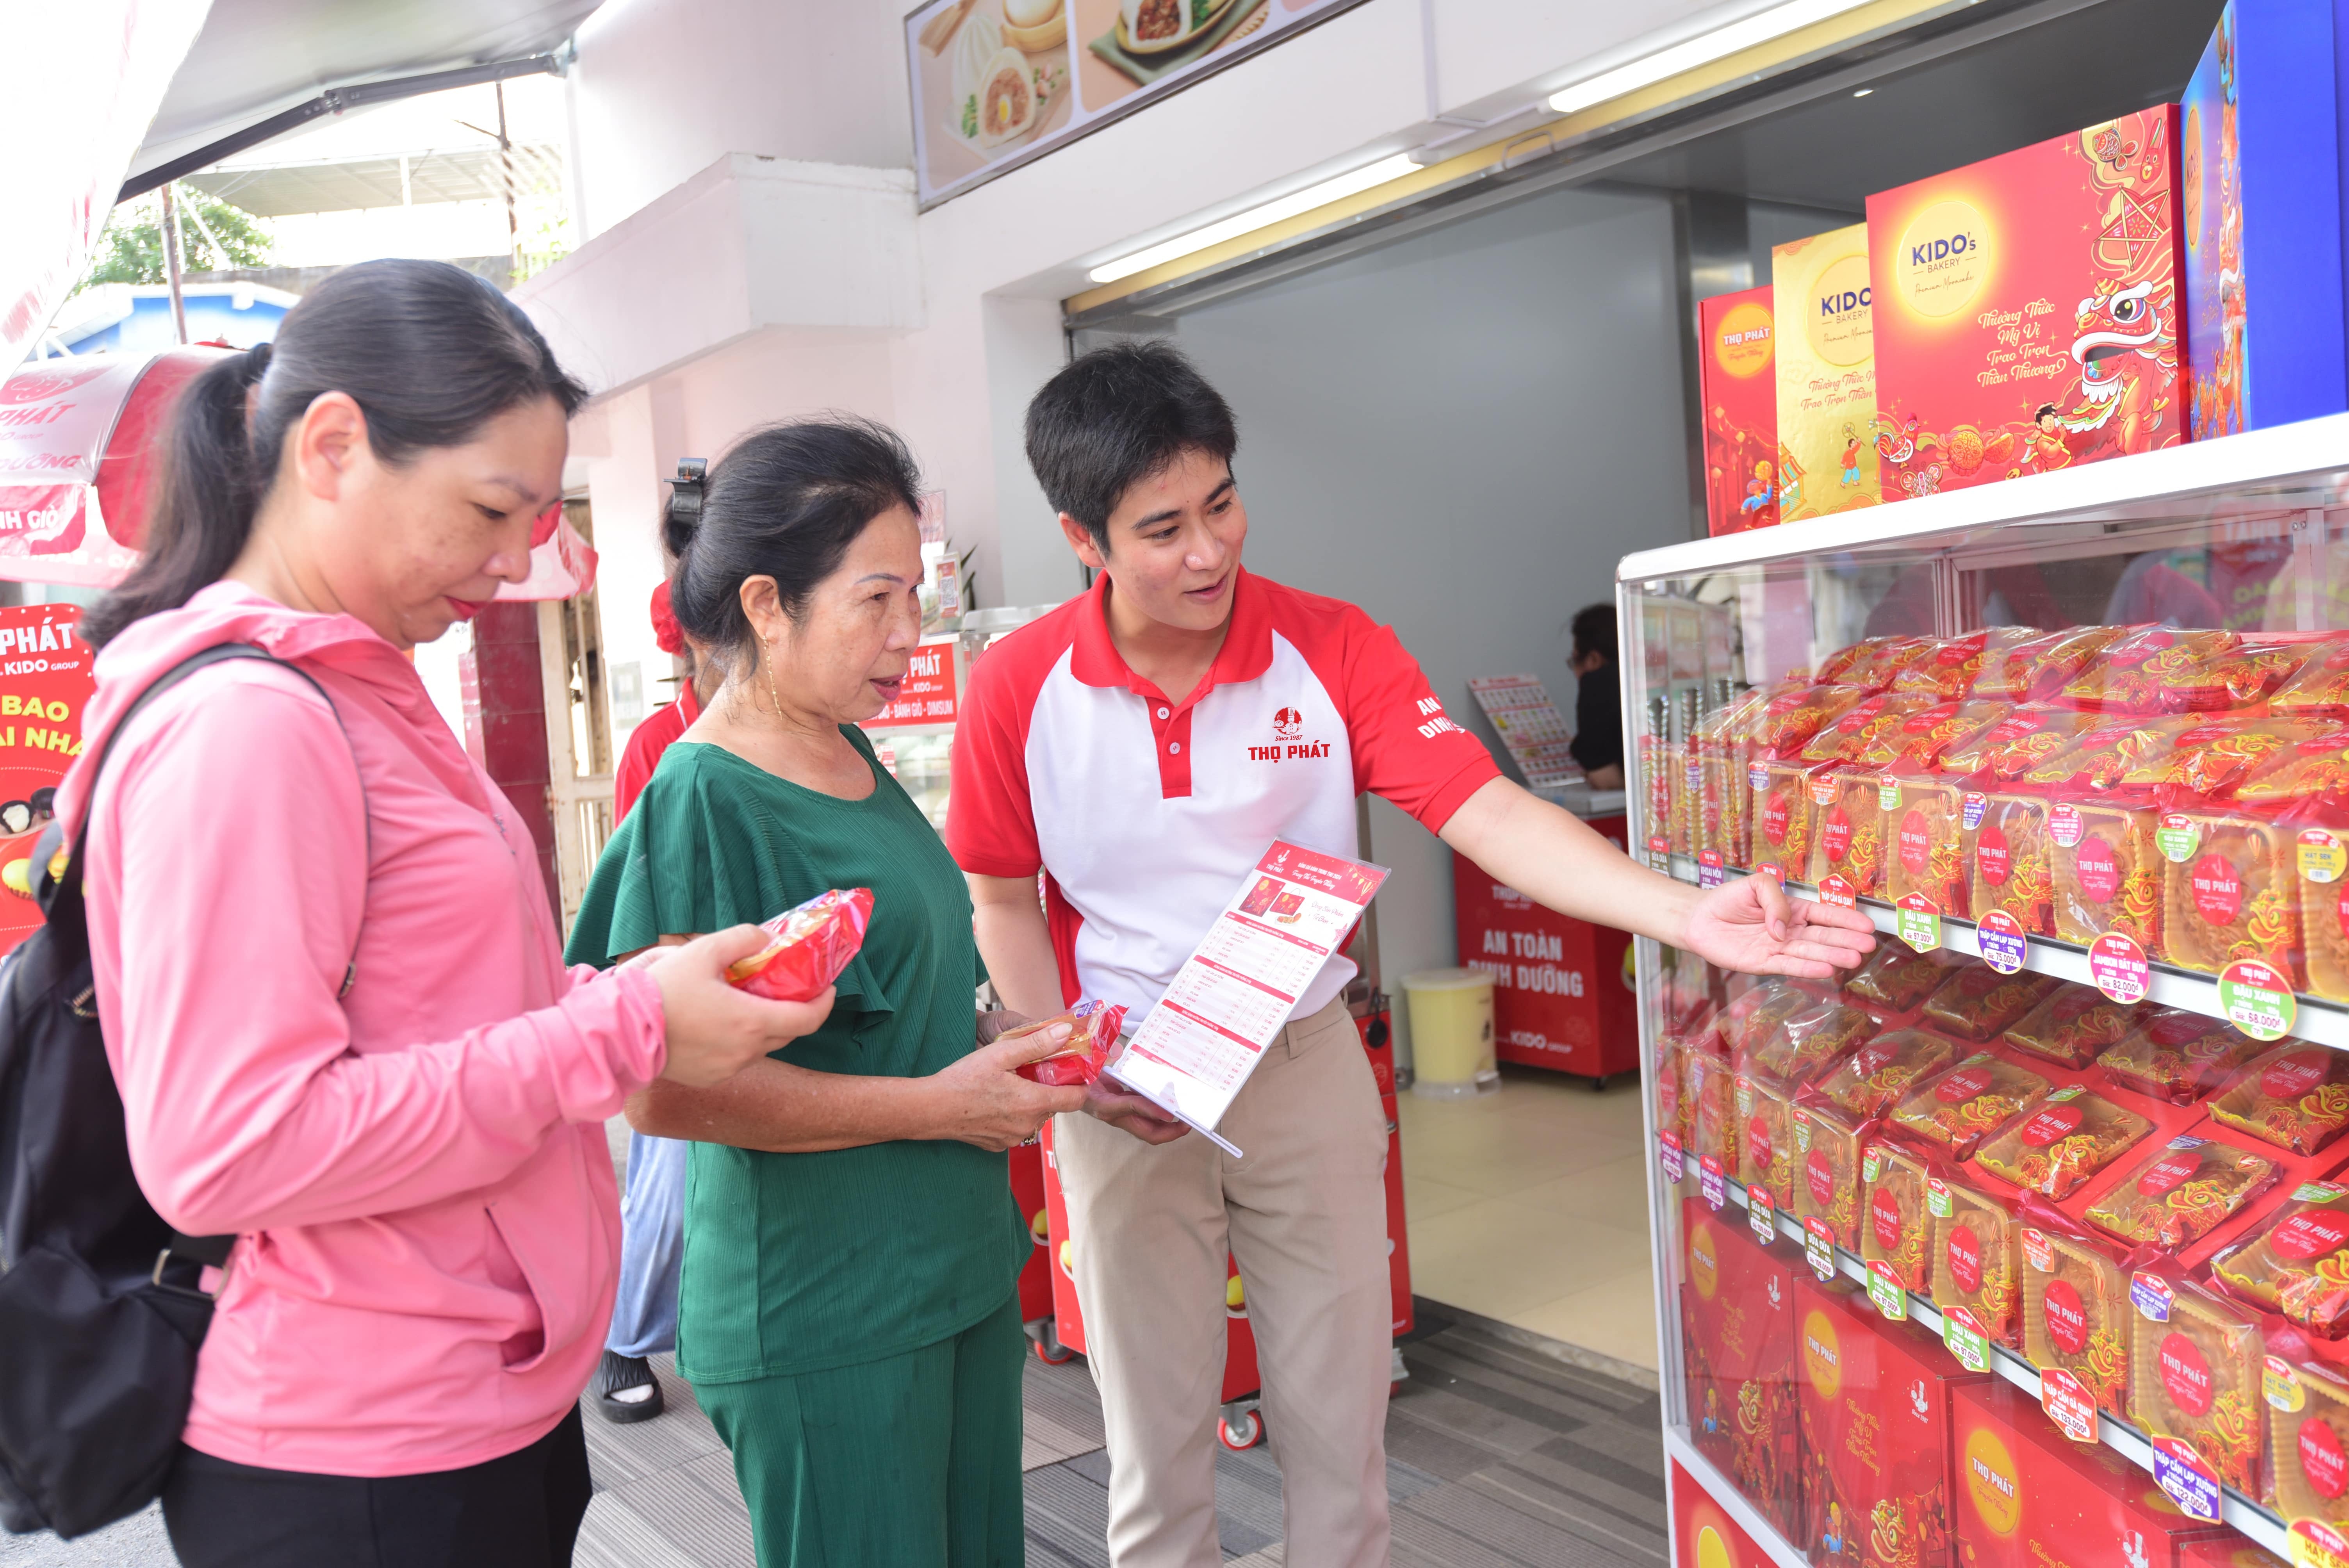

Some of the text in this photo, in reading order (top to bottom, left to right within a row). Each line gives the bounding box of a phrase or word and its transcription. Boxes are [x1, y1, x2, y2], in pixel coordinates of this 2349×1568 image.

[1912, 232, 1977, 266] KIDO's
[1927, 258, 1960, 273] BAKERY
[1915, 283, 1942, 297] Premium
[1836, 309, 1868, 324] BAKERY
[2025, 298, 2056, 317] Thức
[1723, 326, 1770, 347] THỌ PHÁT
[1997, 321, 2041, 346] Mỹ Vị
[1987, 350, 2016, 366] Trao
[1801, 397, 1821, 411] Trao
[0, 617, 73, 656] PHÁT
[5, 659, 80, 676] KIDO GROUP
[910, 648, 941, 677] PHÁT
[913, 682, 930, 693] KIDO
[2, 695, 70, 722] BAO
[894, 700, 911, 718] BÁNH
[911, 698, 923, 717] GIÒ
[927, 700, 954, 716] DIMSUM
[1417, 697, 1442, 716] AN
[1248, 740, 1331, 763] THỌ PHÁT
[1901, 831, 1926, 845] THỌ PHÁT
[1979, 846, 2006, 859] THỌ PHÁT
[1701, 866, 1722, 879] KHOAI MÔN
[2079, 860, 2113, 872] THỌ PHÁT
[2193, 878, 2237, 893] THỌ PHÁT
[1843, 895, 1852, 907] QUAY
[1905, 911, 1931, 925] ĐẬU XANH
[1483, 928, 1562, 961] AN TOÀN
[1980, 930, 1989, 941] THẬP
[1991, 930, 1999, 941] CẨM
[2093, 954, 2118, 969] JAMBON
[2118, 958, 2131, 971] BÁT
[1517, 964, 1584, 998] DƯỠNG
[2233, 984, 2280, 1006] ĐẬU XANH
[1510, 1030, 1546, 1050] KIDO
[2276, 1059, 2322, 1080] THỌ PHÁT
[1950, 1074, 1983, 1092] THỌ PHÁT
[2037, 1113, 2073, 1132] THỌ PHÁT
[1807, 1166, 1830, 1184] THỌ PHÁT
[2154, 1162, 2192, 1177] THỌ PHÁT
[1873, 1205, 1897, 1225] THỌ PHÁT
[2288, 1217, 2343, 1243] THỌ PHÁT
[1950, 1242, 1978, 1267] THỌ PHÁT
[1873, 1274, 1898, 1296] ĐẬU XANH
[2046, 1298, 2083, 1327] THỌ PHÁT
[1951, 1321, 1980, 1346] ĐẬU XANH
[1808, 1335, 1837, 1366] THỌ PHÁT
[2162, 1352, 2208, 1388] THỌ PHÁT
[2044, 1383, 2092, 1419] THẬP CẨM GÀ QUAY
[1920, 1413, 1929, 1424] 1987
[1849, 1428, 1863, 1445] Trao
[2154, 1449, 2170, 1469] THẬP
[2170, 1456, 2183, 1476] CẨM
[2183, 1470, 2196, 1484] LẠP
[1972, 1457, 2014, 1499] THỌ PHÁT
